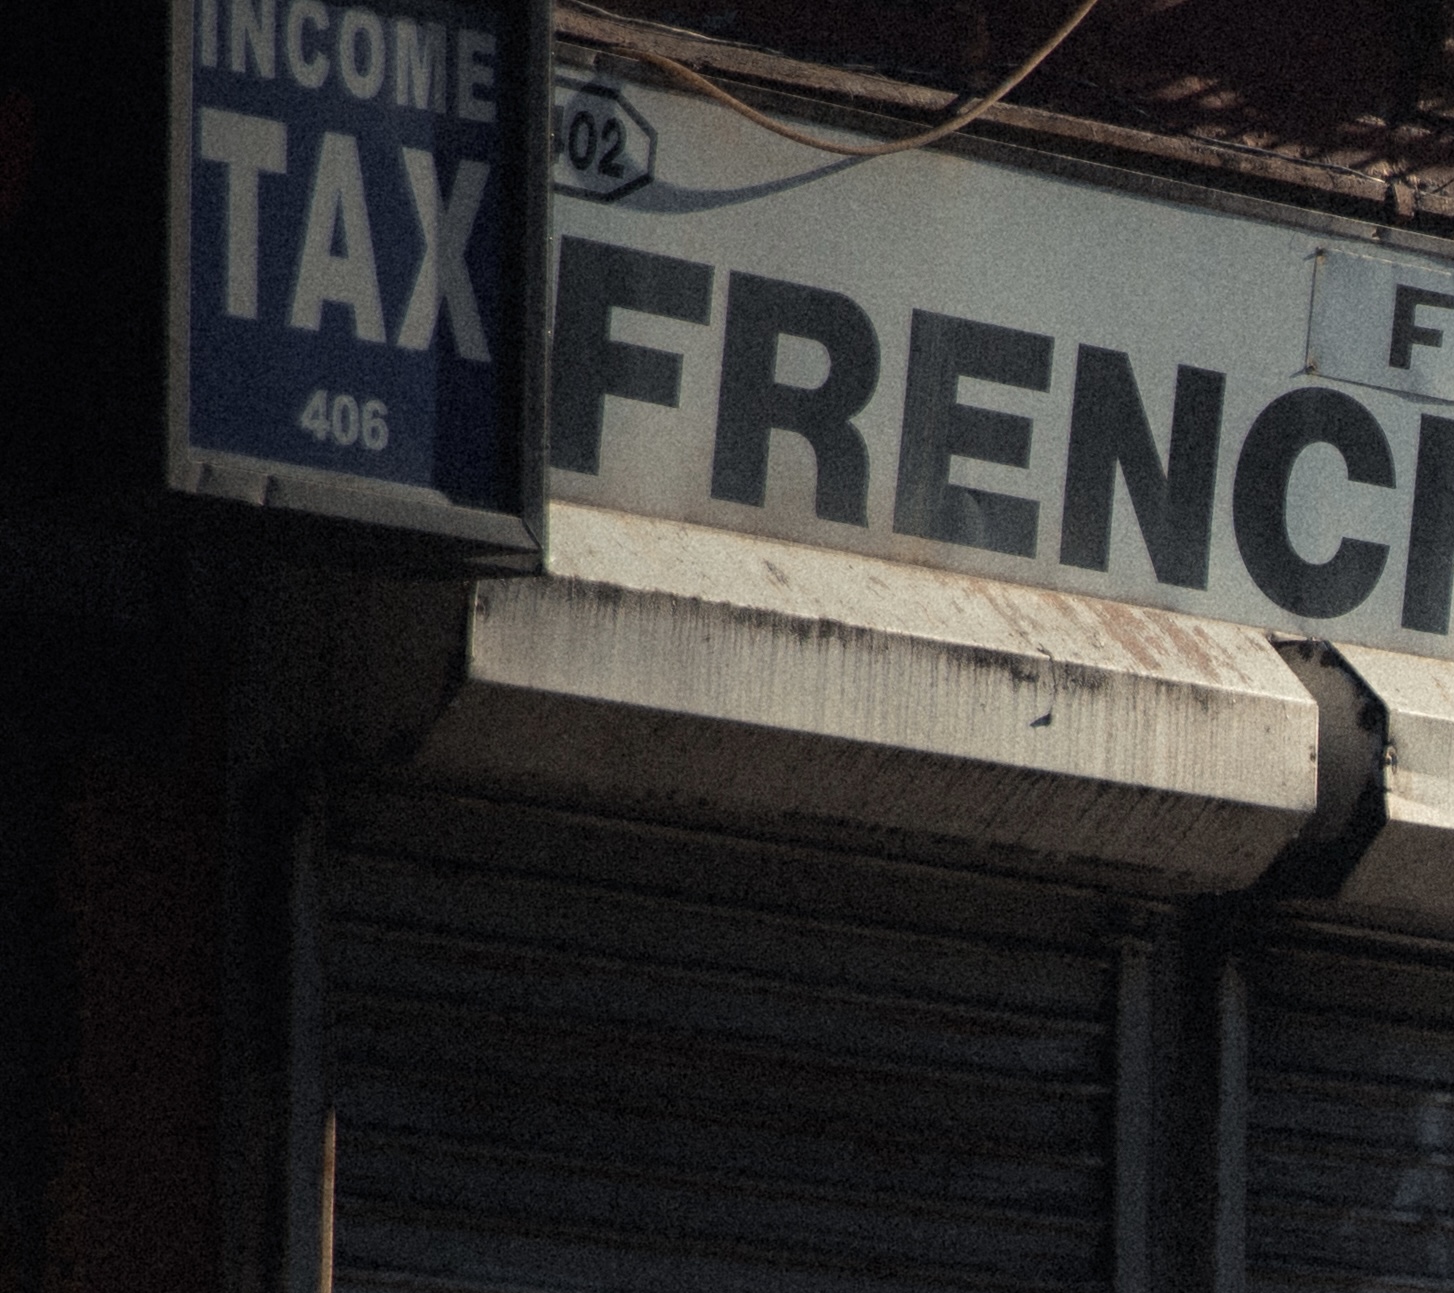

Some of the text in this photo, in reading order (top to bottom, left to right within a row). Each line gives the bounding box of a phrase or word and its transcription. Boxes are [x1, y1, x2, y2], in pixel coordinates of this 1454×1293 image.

[199, 0, 498, 123] INCOME
[200, 106, 491, 363] TAX
[301, 389, 389, 452] 406
